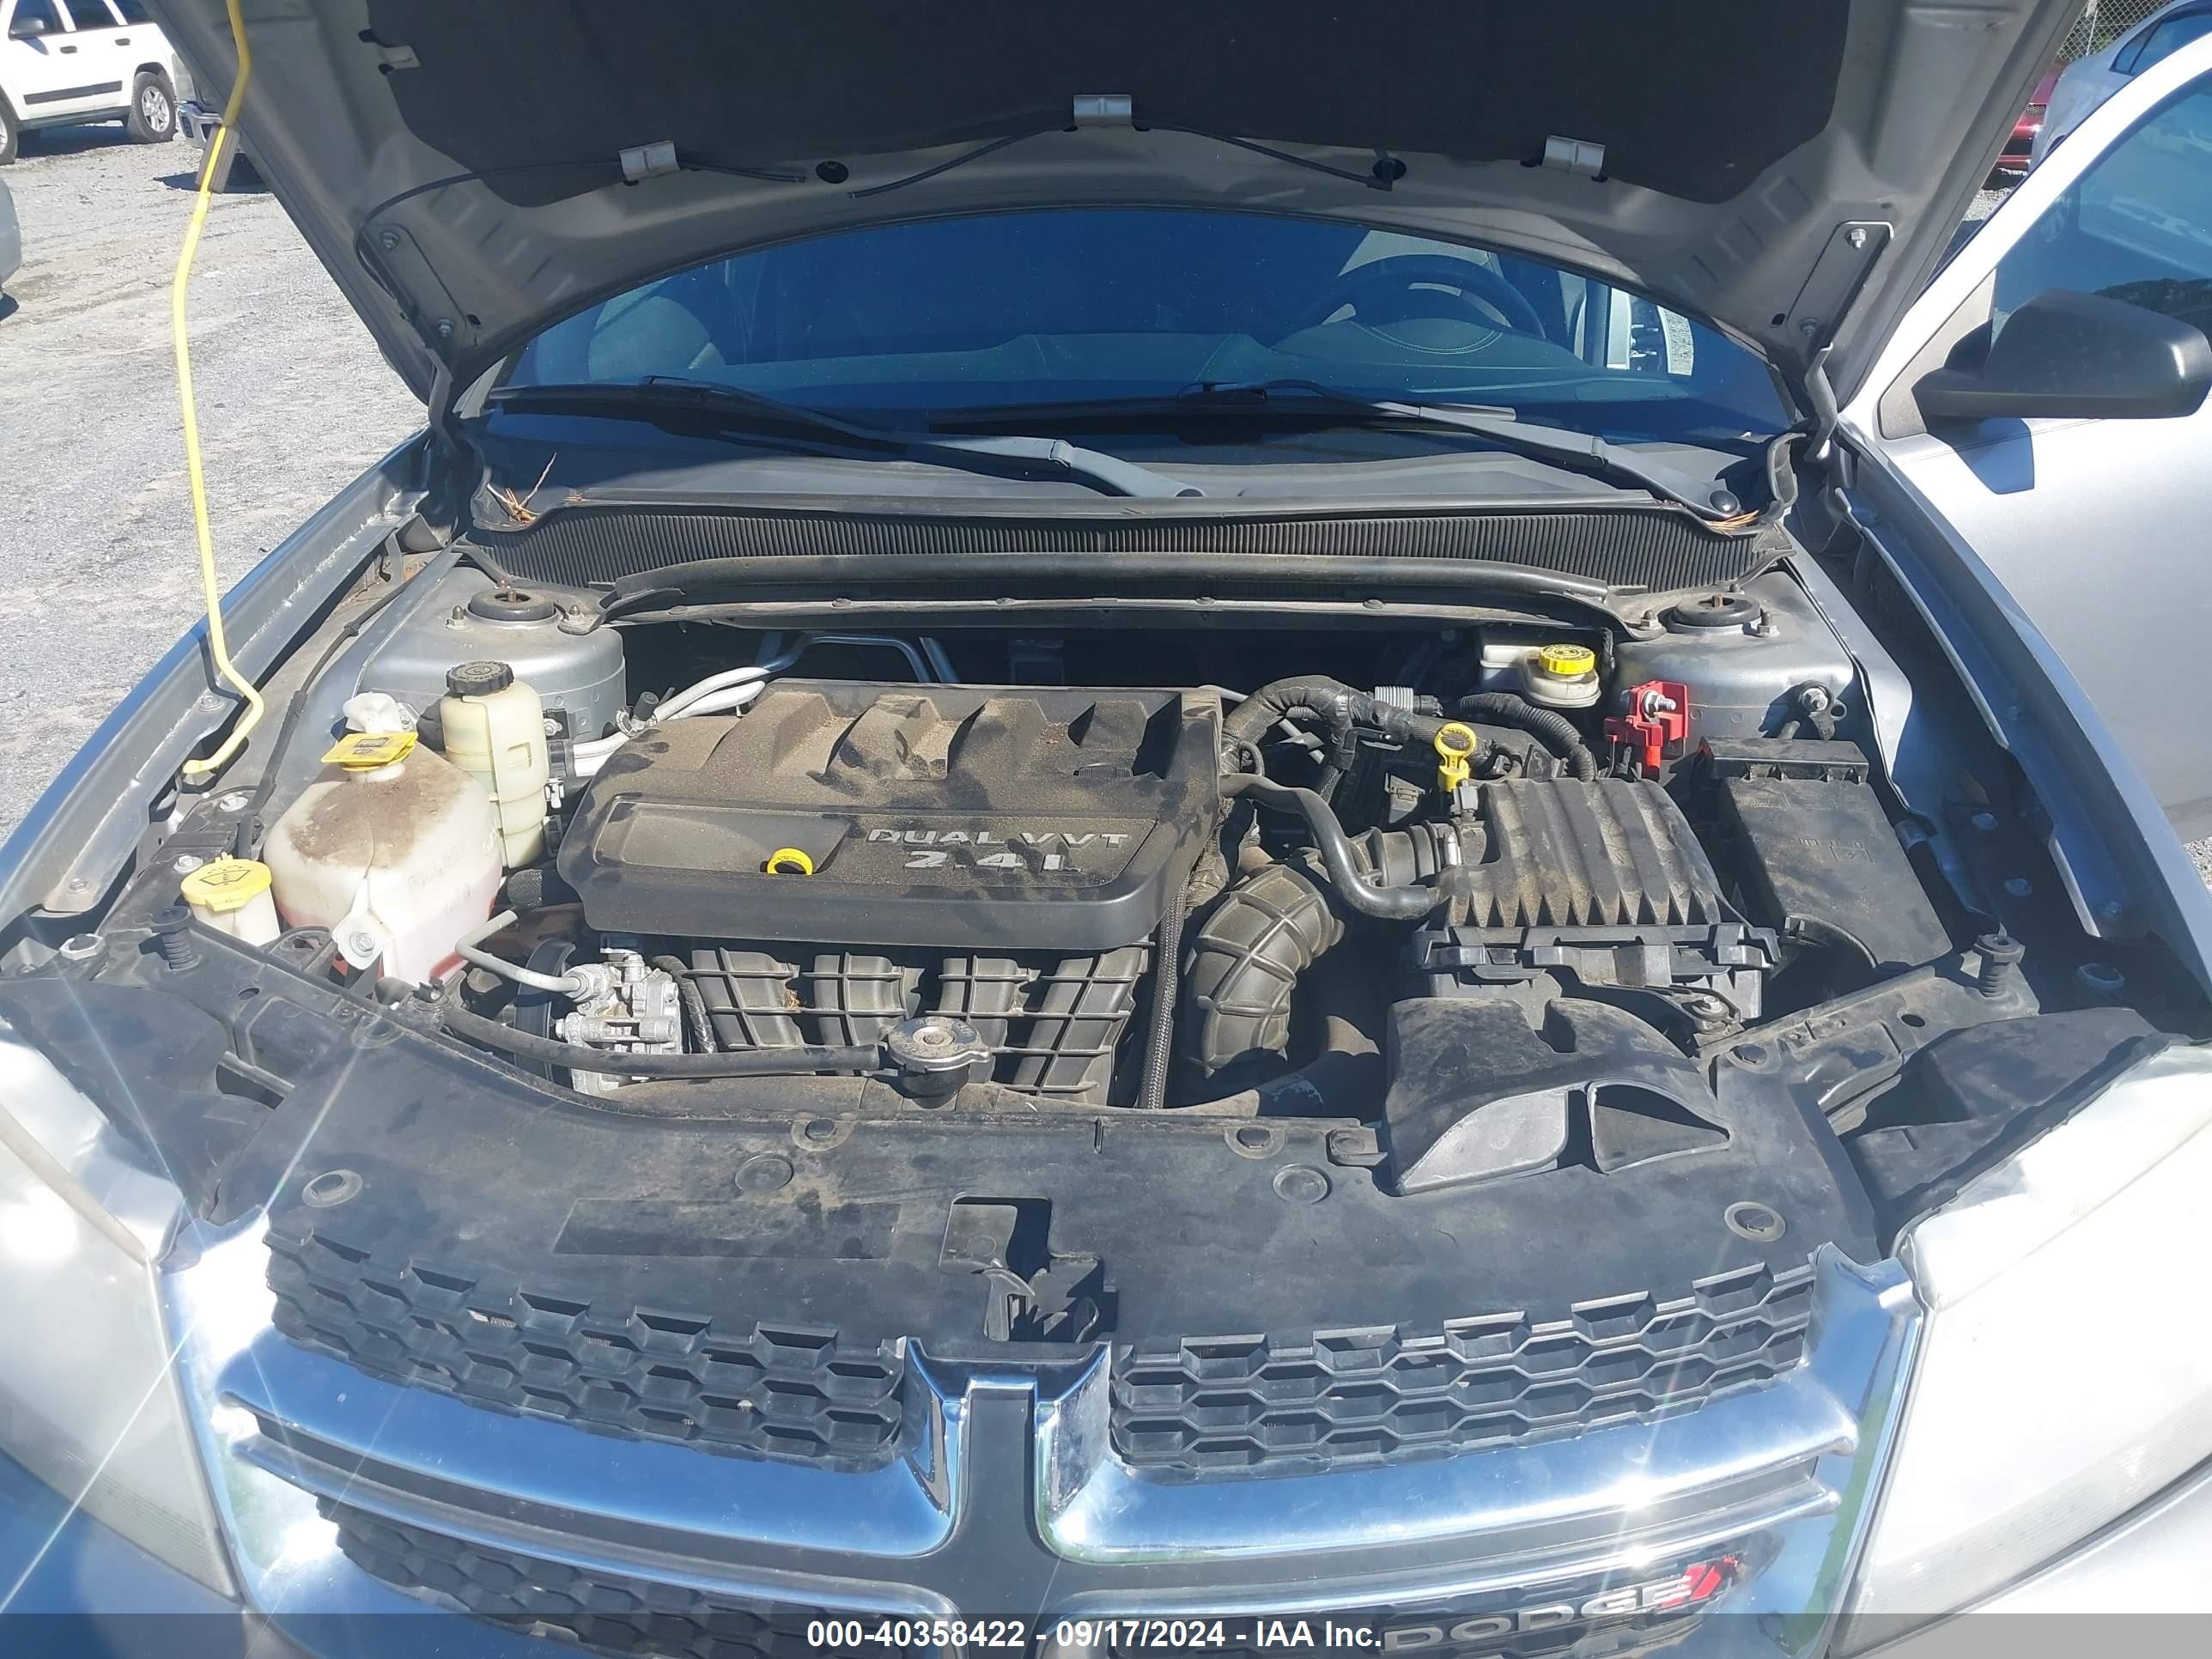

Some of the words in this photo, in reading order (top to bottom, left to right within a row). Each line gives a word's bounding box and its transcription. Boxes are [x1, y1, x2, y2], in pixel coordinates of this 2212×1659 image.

[865, 828, 1006, 845] DUAL
[1019, 831, 1129, 848] VVT
[1382, 1575, 1693, 1652] DODGE
